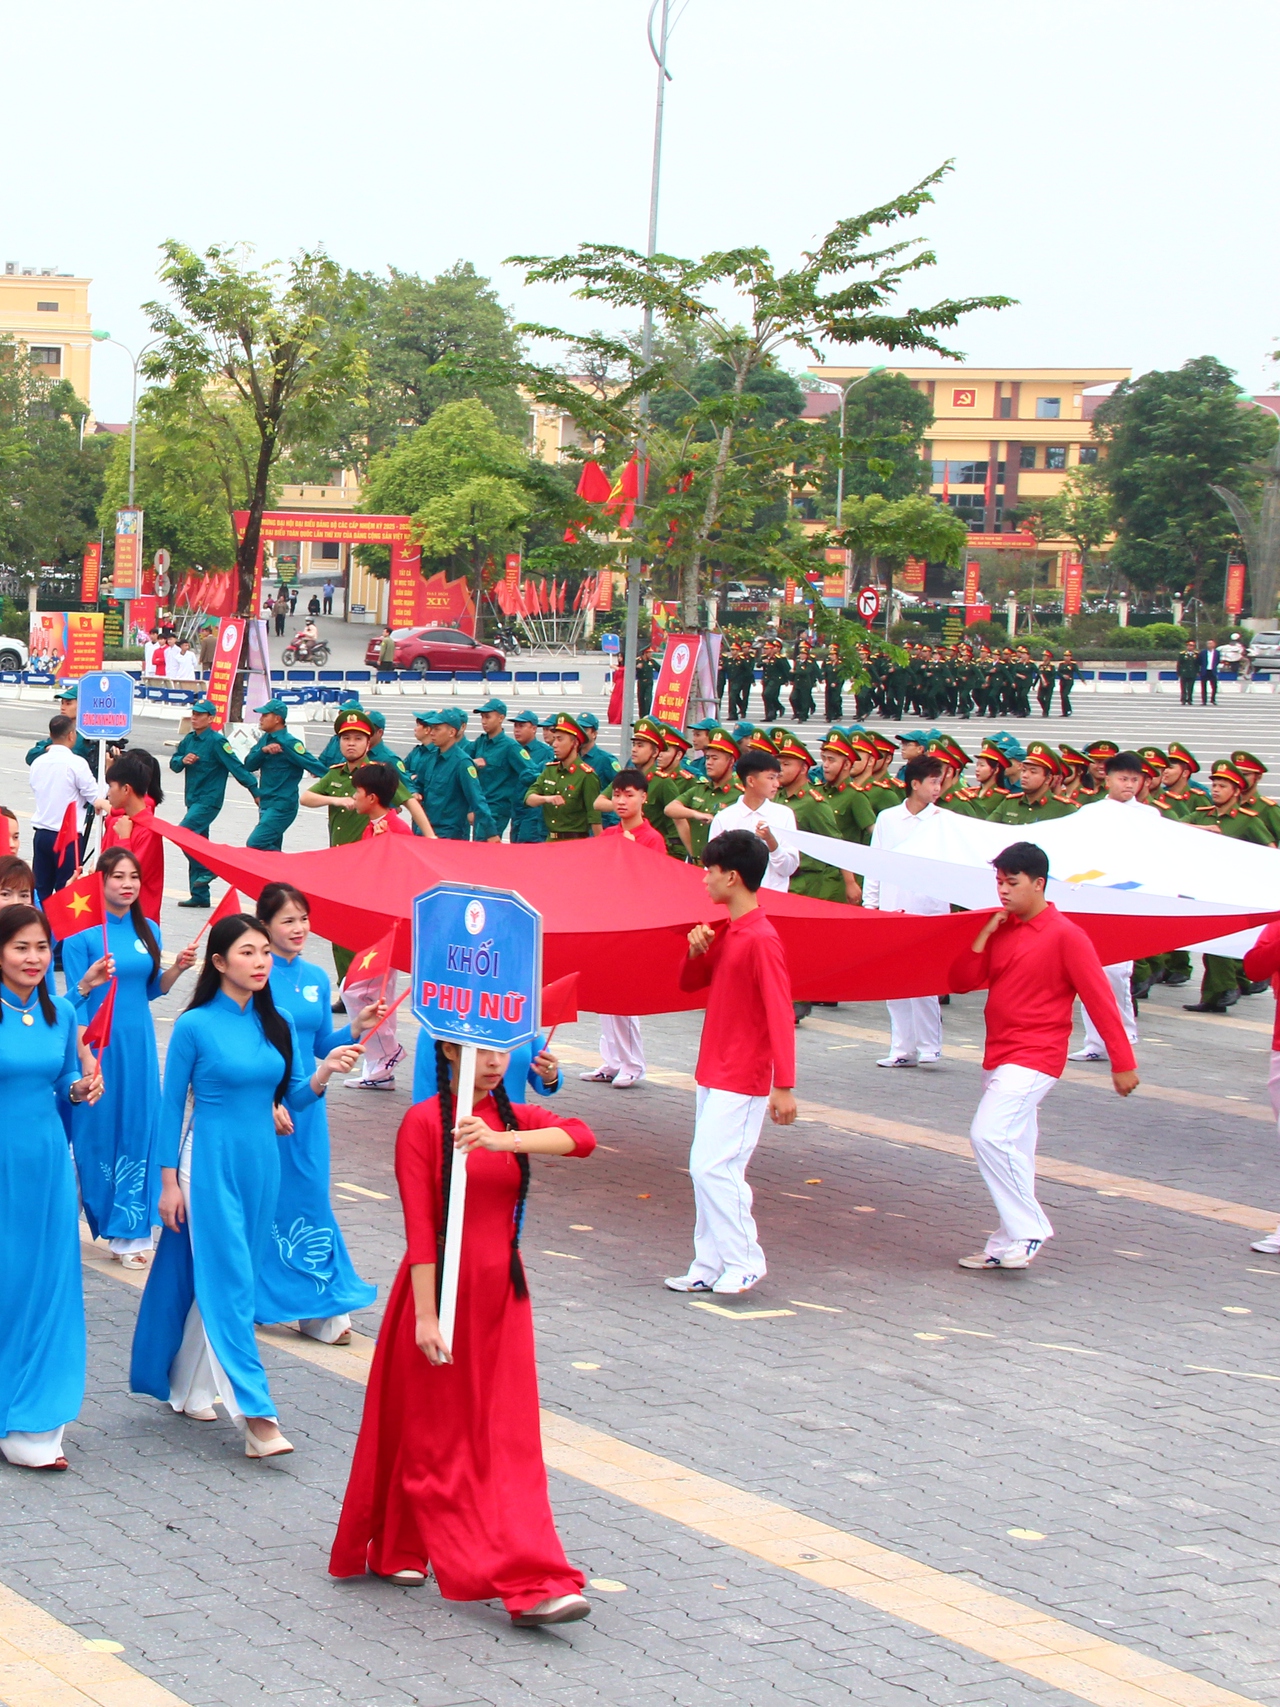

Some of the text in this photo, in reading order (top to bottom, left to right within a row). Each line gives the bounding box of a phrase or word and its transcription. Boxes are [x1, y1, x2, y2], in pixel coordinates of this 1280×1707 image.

[93, 692, 116, 709] KHỐI
[446, 938, 500, 978] KHỐI
[421, 981, 527, 1023] PHỤ NỮ
